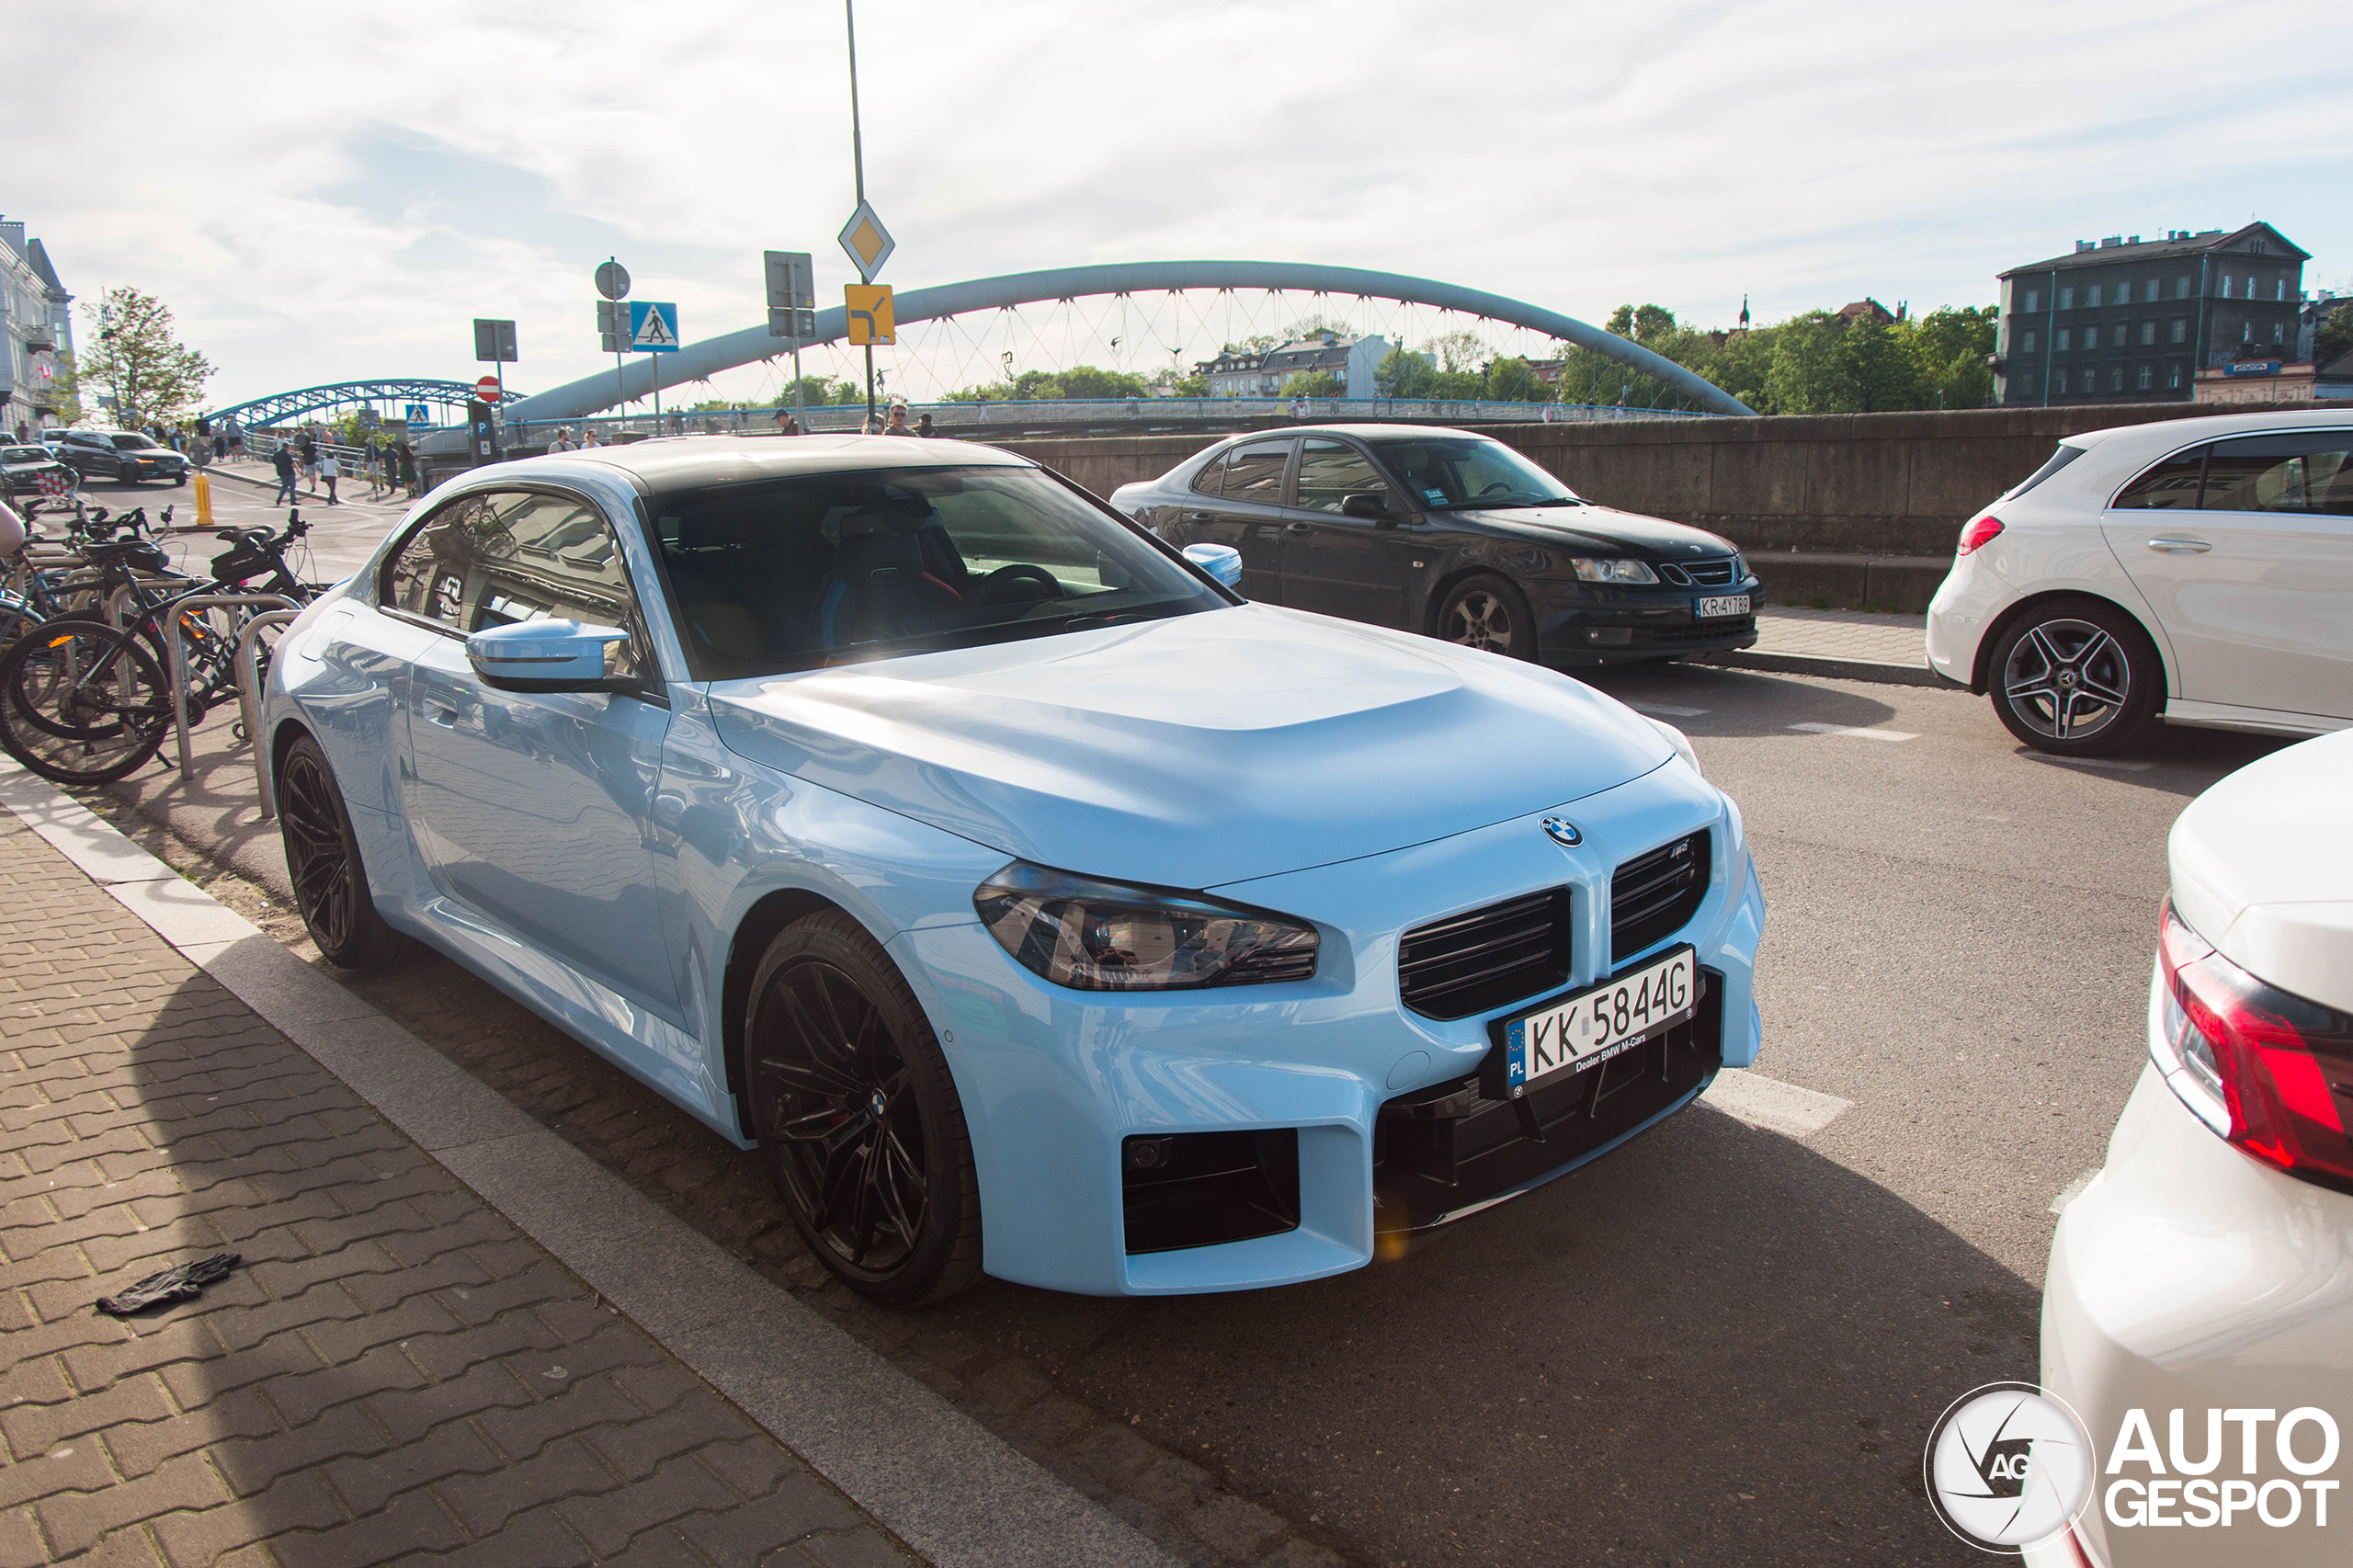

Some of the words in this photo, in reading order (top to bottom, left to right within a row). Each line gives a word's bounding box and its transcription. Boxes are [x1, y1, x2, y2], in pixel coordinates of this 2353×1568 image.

[479, 422, 486, 433] P
[1701, 598, 1719, 616] KR
[1722, 597, 1748, 614] 4Y789
[1533, 1006, 1578, 1073] KK
[1594, 961, 1686, 1046] 5844G
[1575, 1054, 1600, 1073] Dealer
[1601, 1044, 1621, 1061] BMW
[1621, 1034, 1646, 1051] M-Cars
[1510, 1061, 1524, 1077] PL
